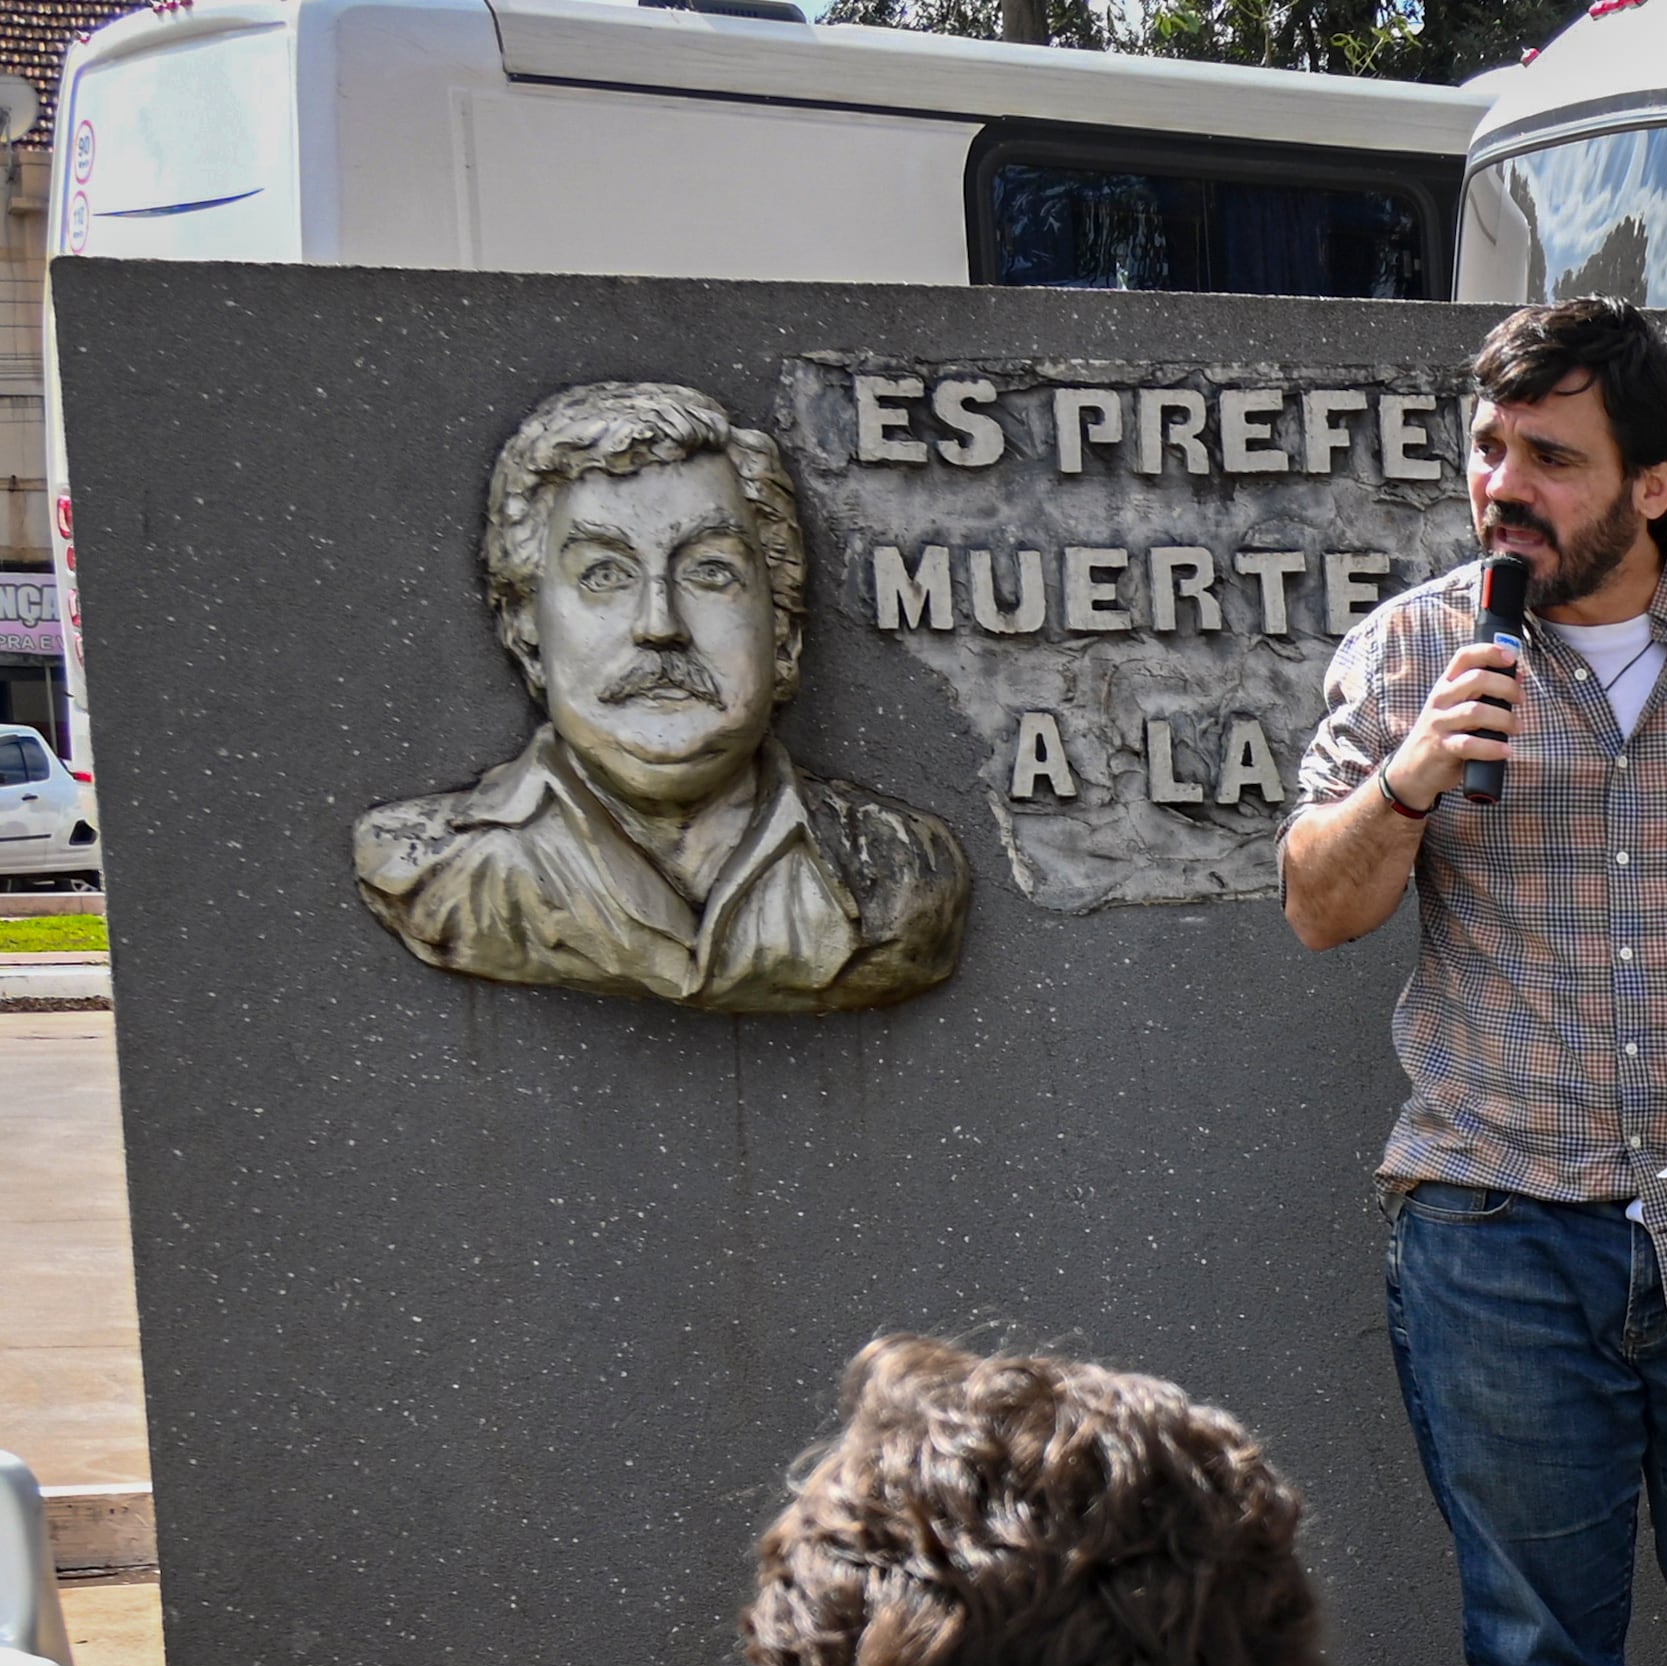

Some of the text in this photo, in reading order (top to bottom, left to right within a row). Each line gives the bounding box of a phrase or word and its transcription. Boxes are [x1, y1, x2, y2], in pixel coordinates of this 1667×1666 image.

[853, 374, 1004, 467] ES
[874, 545, 1392, 635] MUERTE
[40, 634, 53, 651] E
[1010, 711, 1078, 799] A
[1146, 716, 1286, 804] LA
